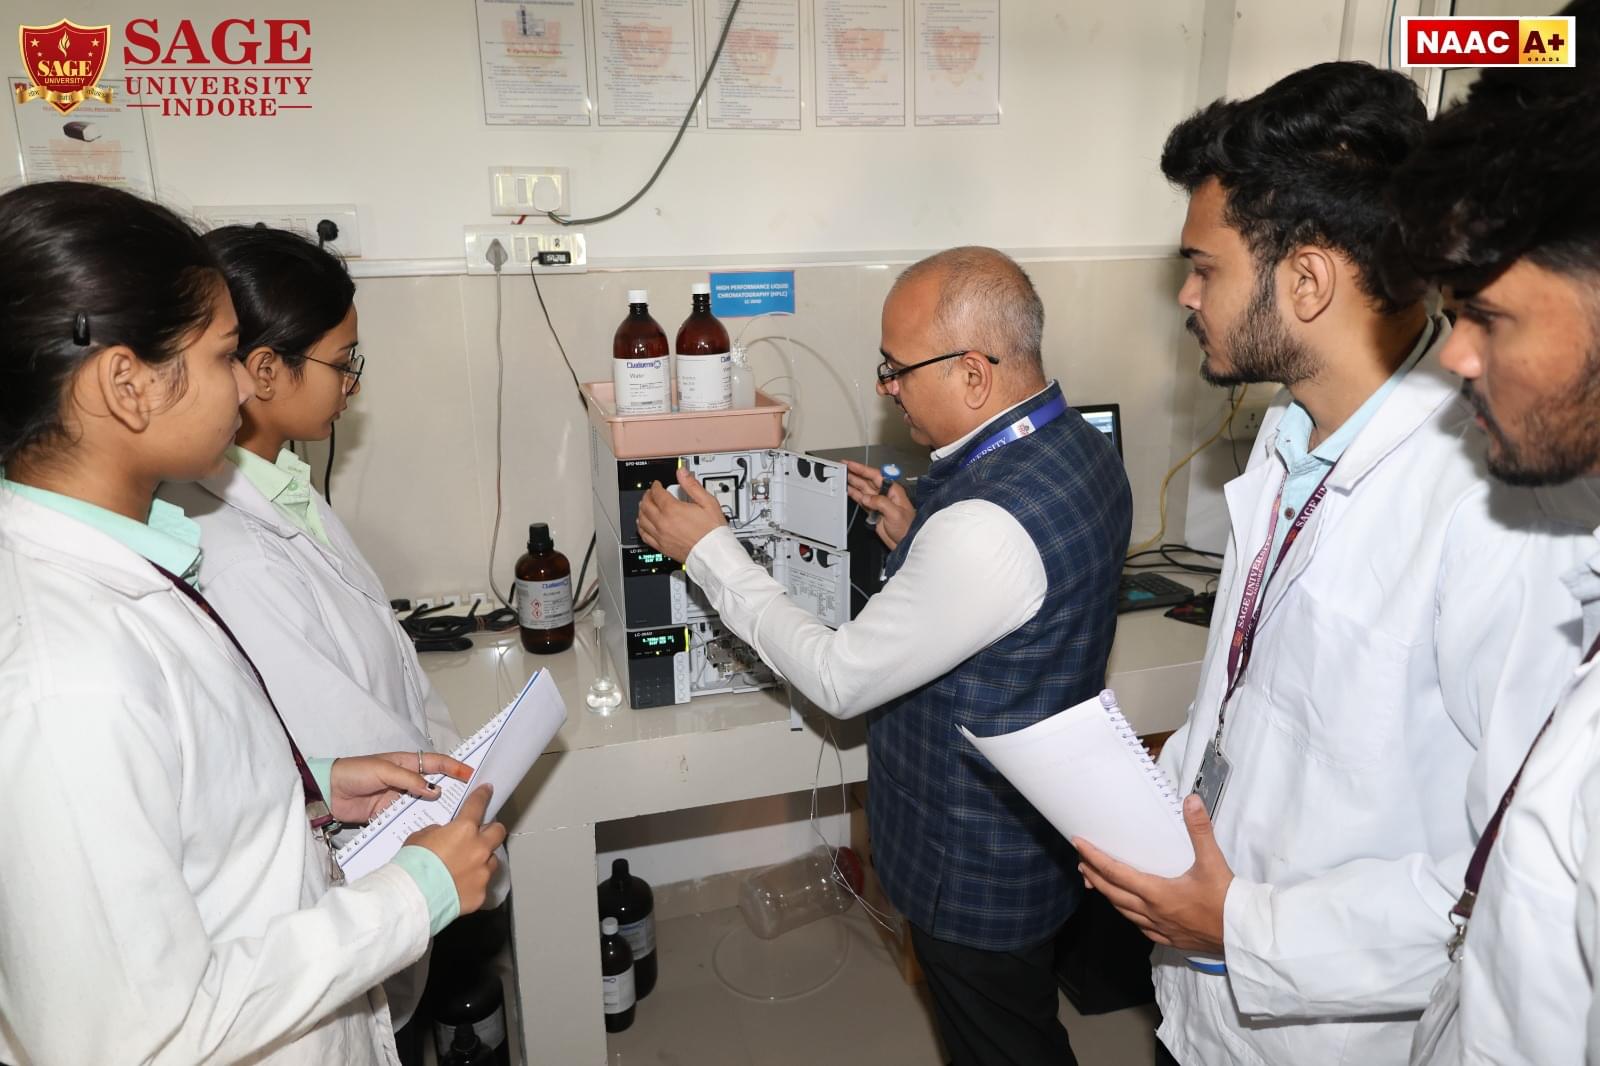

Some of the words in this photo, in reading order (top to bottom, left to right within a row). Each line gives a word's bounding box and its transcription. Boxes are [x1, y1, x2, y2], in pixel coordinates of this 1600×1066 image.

[1295, 497, 1318, 529] SAGE
[1236, 598, 1252, 629] SAGE
[1245, 534, 1273, 598] UNIVERSITY
